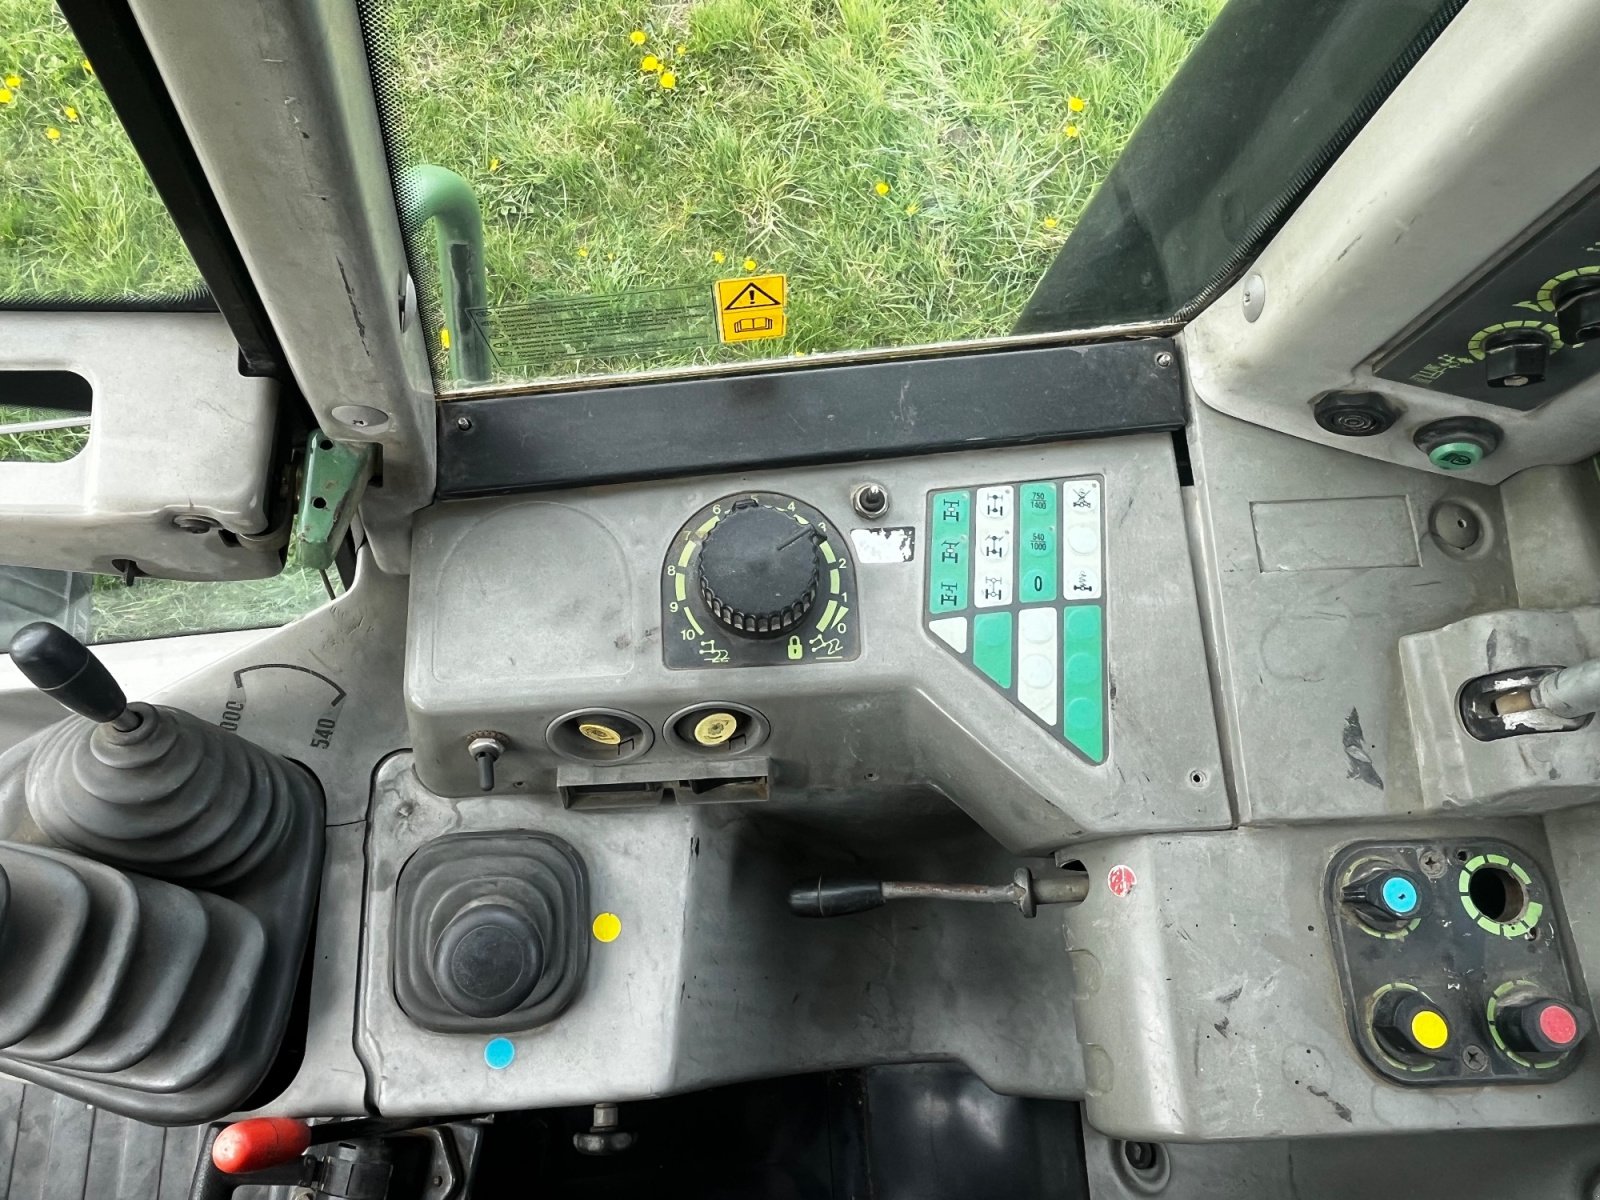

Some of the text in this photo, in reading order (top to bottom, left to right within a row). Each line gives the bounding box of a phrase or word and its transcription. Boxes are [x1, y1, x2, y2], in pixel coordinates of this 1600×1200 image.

[712, 504, 721, 515] 6
[787, 501, 796, 512] 4
[838, 558, 847, 569] 2
[667, 565, 676, 576] 8
[841, 592, 848, 602] 1
[669, 602, 679, 613] 9
[837, 623, 847, 634] 0
[680, 629, 696, 641] 10
[310, 718, 336, 750] 540
